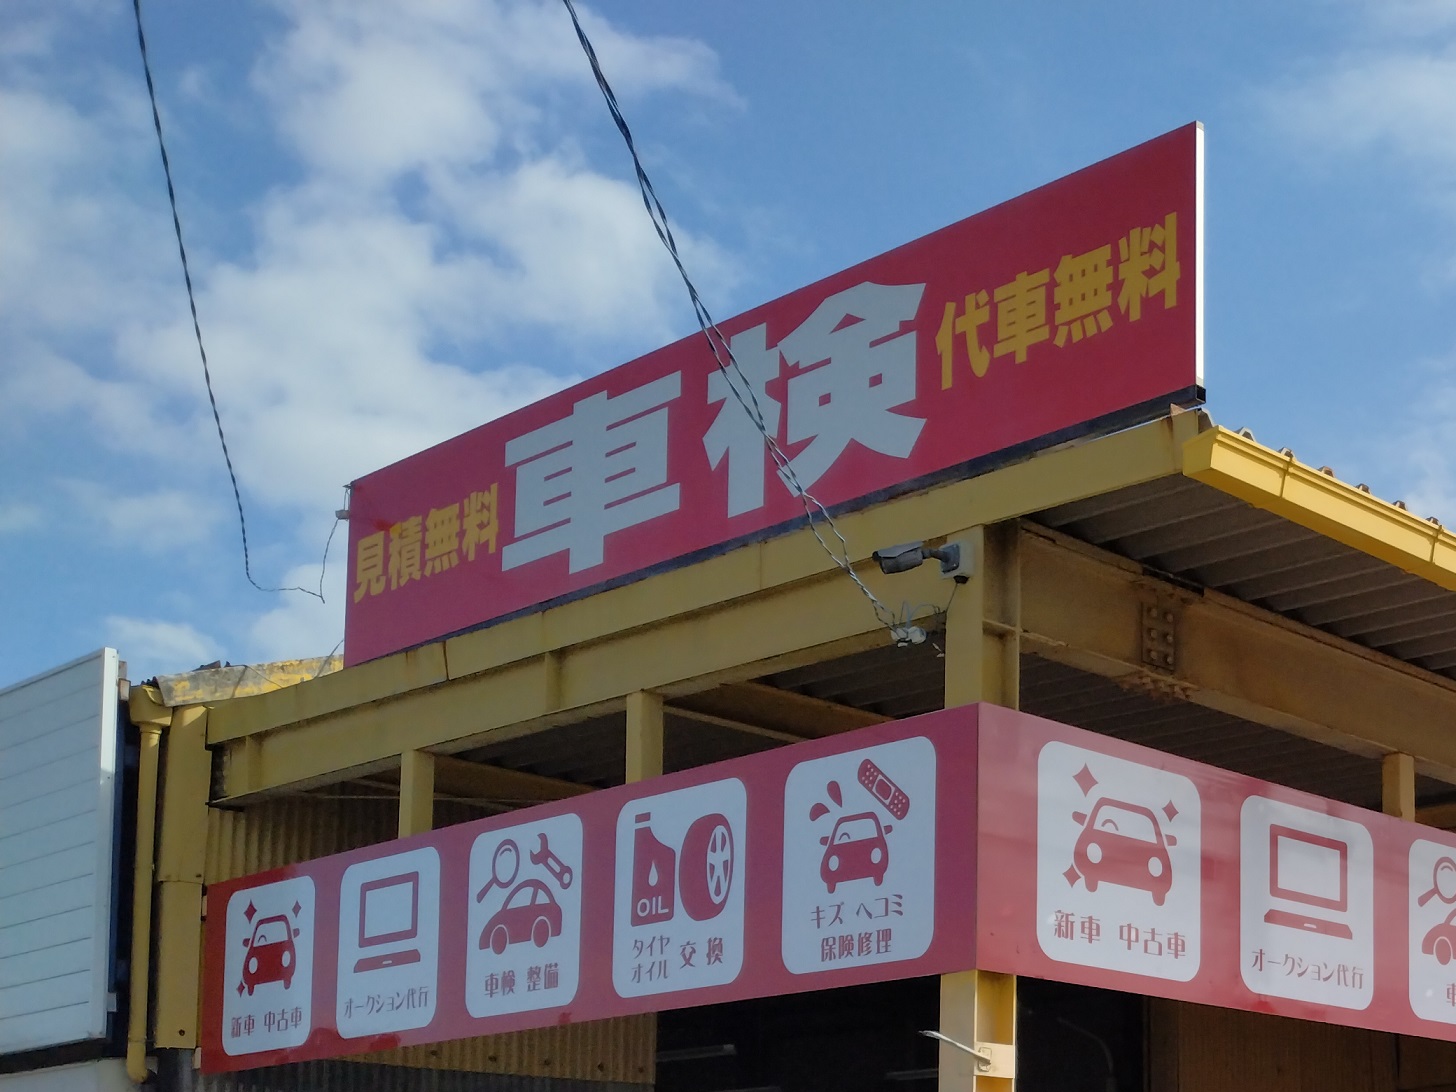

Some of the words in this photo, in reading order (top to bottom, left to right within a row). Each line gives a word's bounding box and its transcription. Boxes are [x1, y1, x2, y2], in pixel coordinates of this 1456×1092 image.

[354, 482, 499, 604] 見積無料
[502, 280, 927, 575] 車検
[936, 212, 1181, 390] 代車無料
[636, 896, 670, 918] OIL
[810, 900, 845, 929] キズ
[855, 893, 905, 921] ヘコミ
[632, 934, 671, 960] タイヤ
[820, 928, 893, 963] 保険修理
[1053, 909, 1101, 945] 新車
[1119, 922, 1186, 960] 中古車
[679, 937, 724, 970] 交換
[1251, 948, 1365, 990] オークション代行
[484, 970, 516, 999] 車検
[526, 962, 560, 992] 整備
[631, 959, 669, 984] オイル
[344, 984, 430, 1020] オークション代行
[230, 1013, 256, 1039] 新車
[263, 1006, 304, 1033] 中古車
